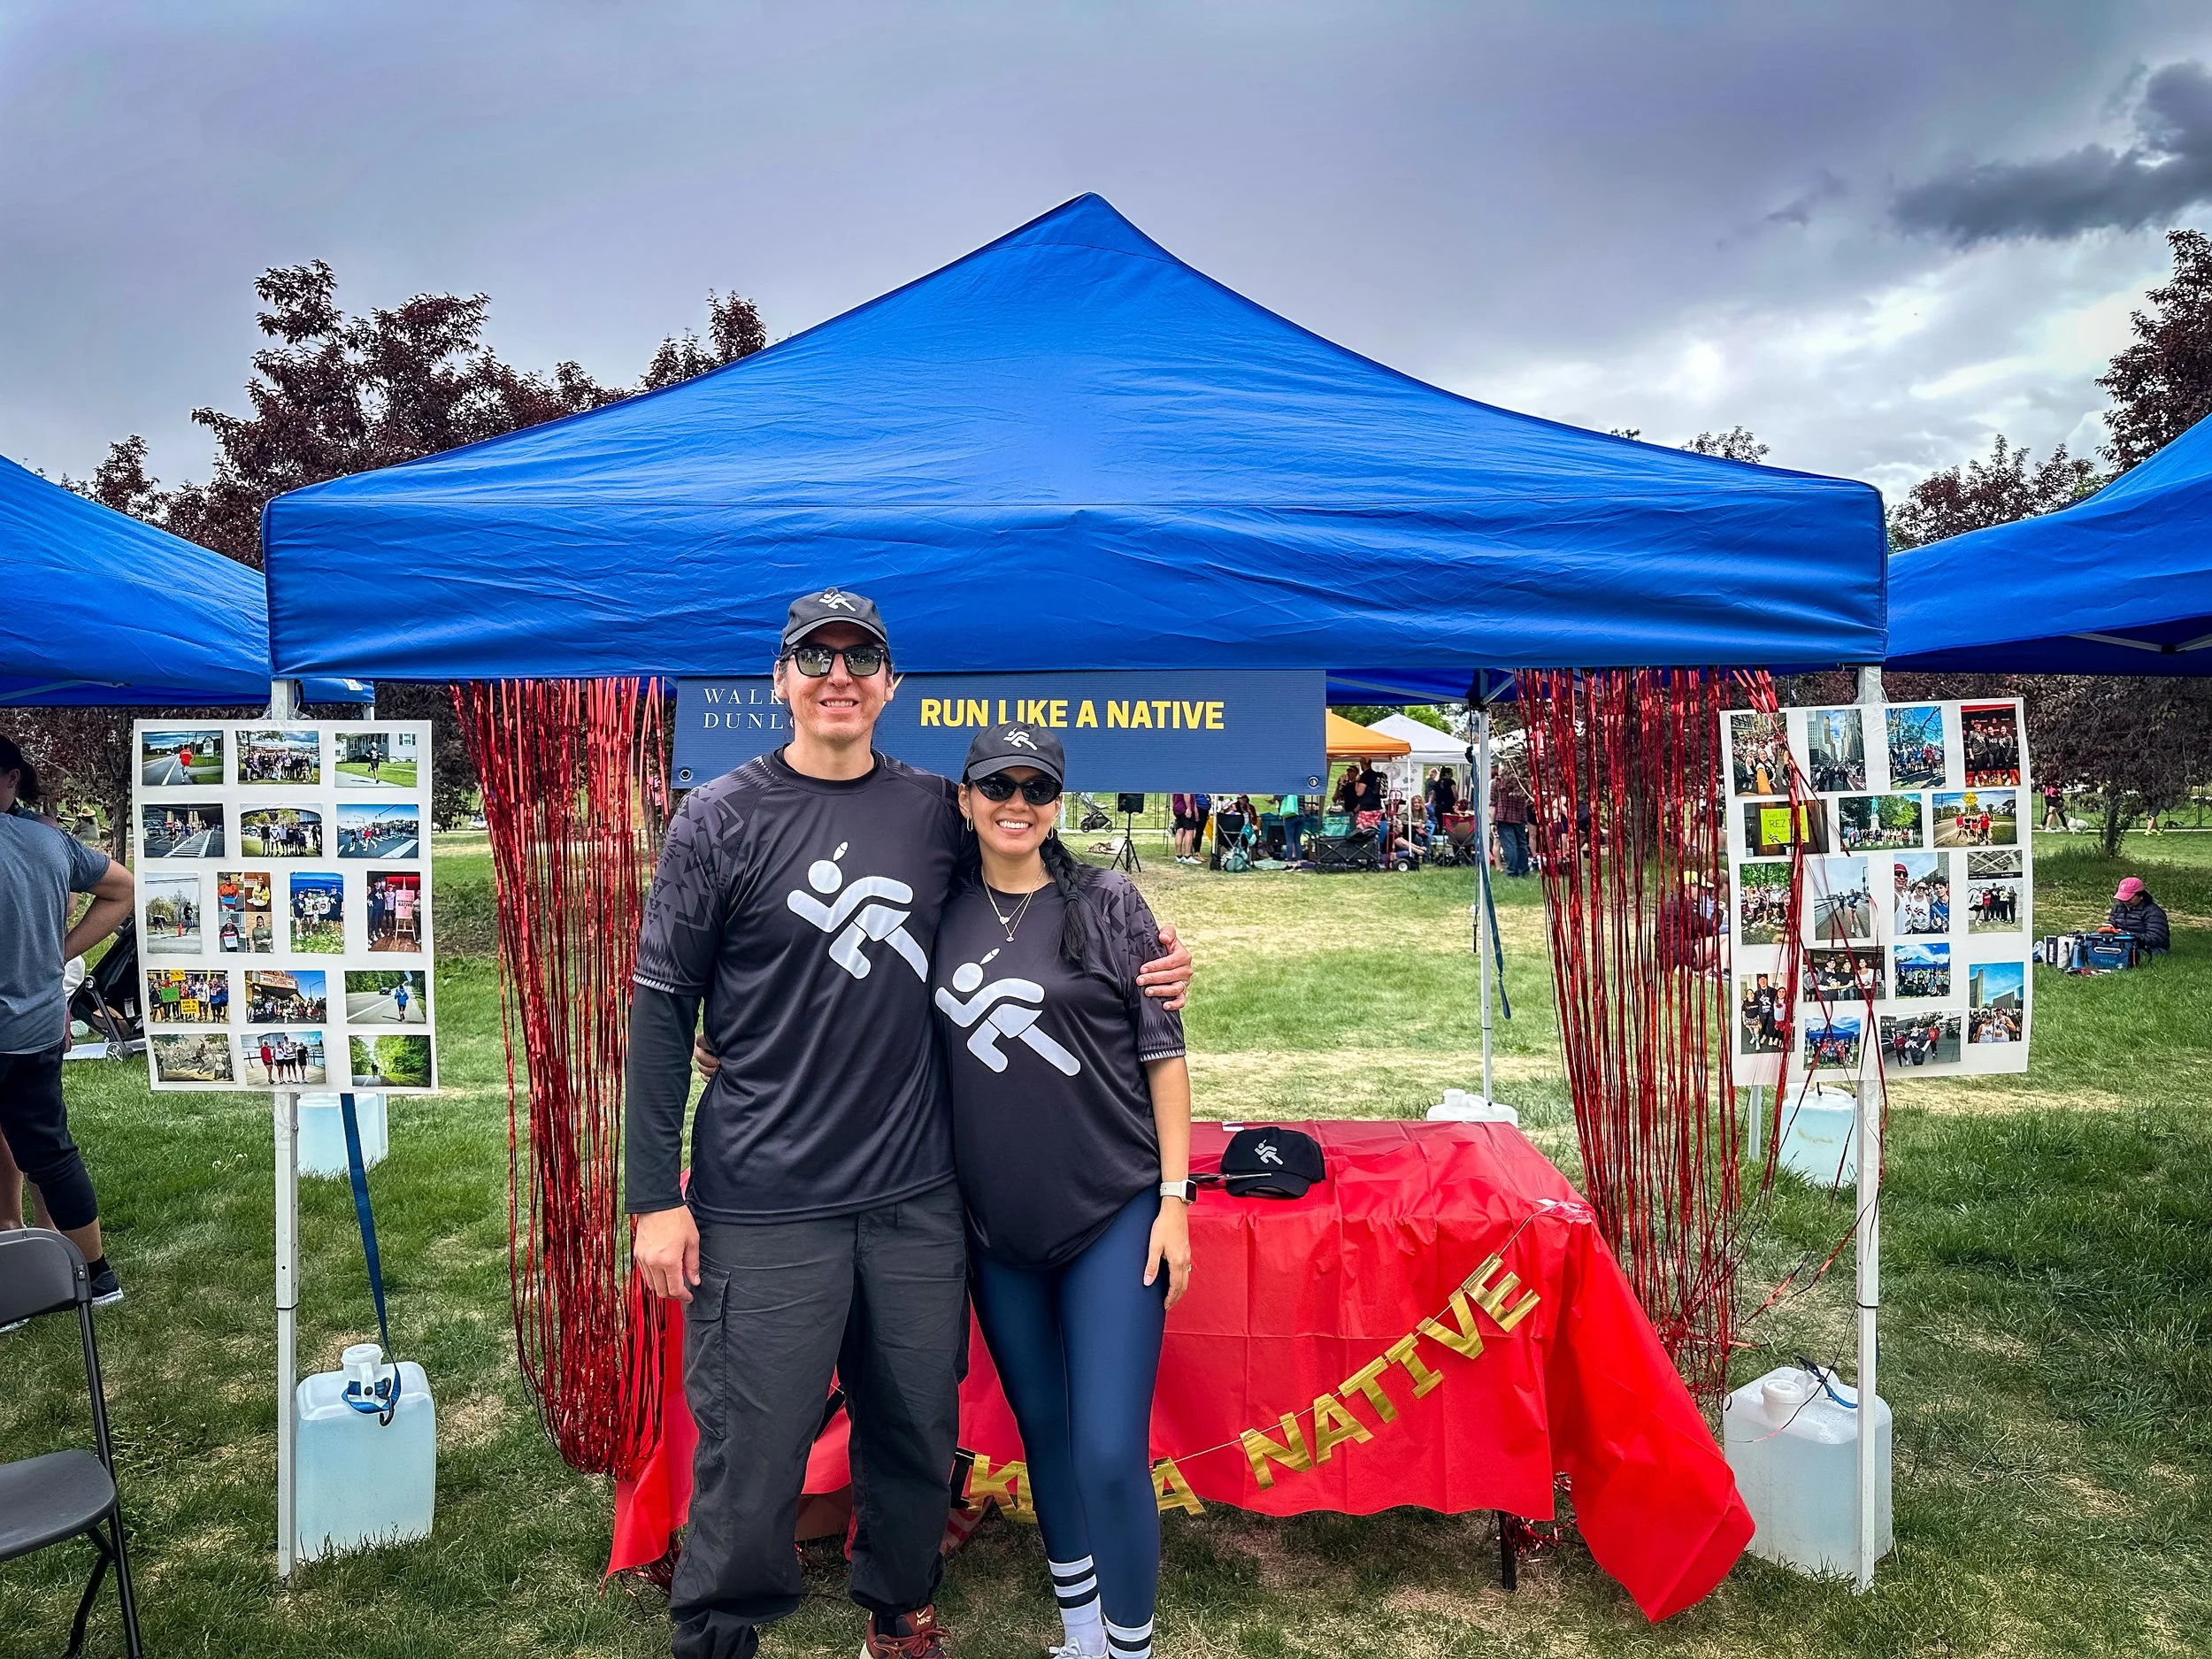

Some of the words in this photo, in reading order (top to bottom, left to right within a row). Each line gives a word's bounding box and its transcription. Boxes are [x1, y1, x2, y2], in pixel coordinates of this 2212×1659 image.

[703, 712, 795, 729] DUNL
[920, 698, 988, 727] RUN
[997, 699, 1068, 727] LIKE
[1075, 700, 1099, 728] A
[1107, 701, 1225, 729] NATIVE
[1150, 1456, 1206, 1517] A
[1239, 1252, 1541, 1490] NATIVE
[916, 1615, 932, 1626] NIKE
